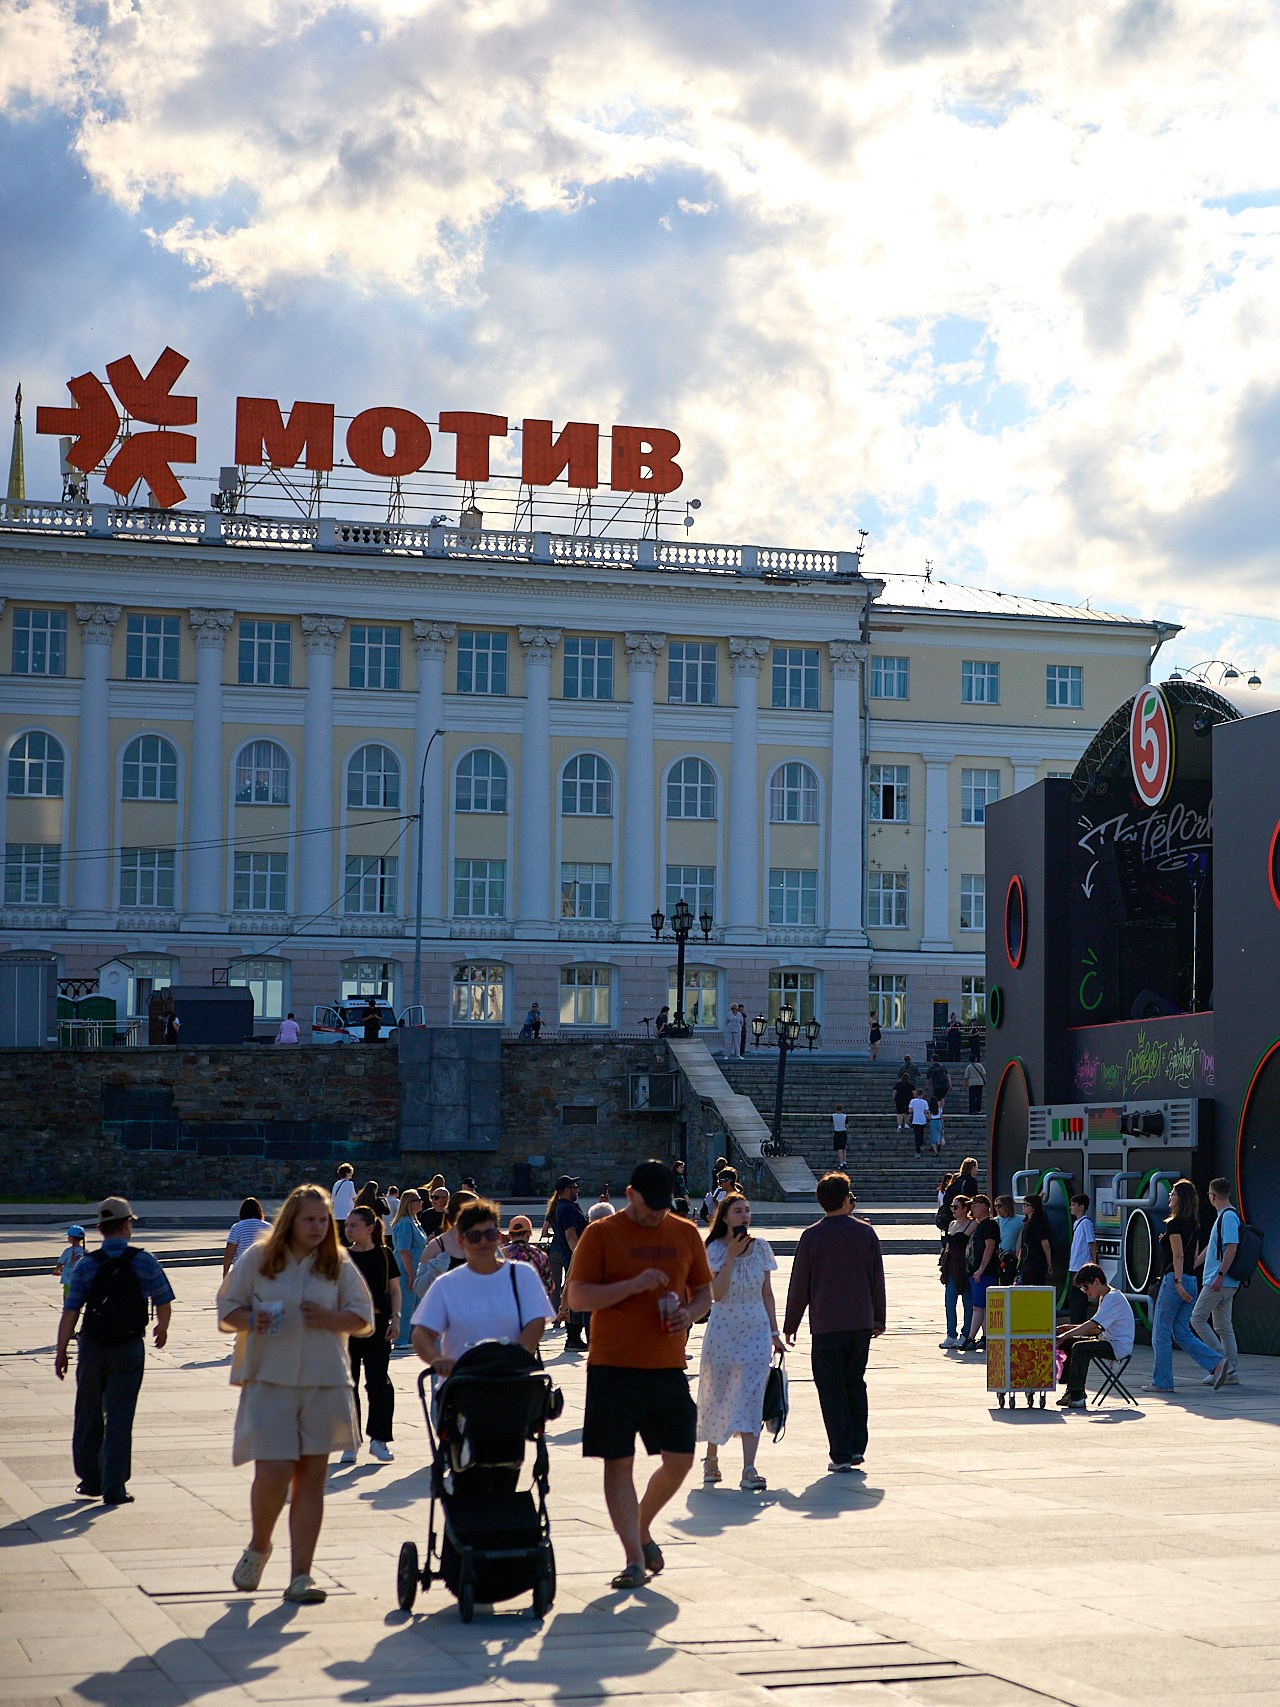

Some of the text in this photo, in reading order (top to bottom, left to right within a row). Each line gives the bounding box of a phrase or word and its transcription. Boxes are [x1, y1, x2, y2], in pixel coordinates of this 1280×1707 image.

[234, 395, 683, 495] МОТИВ
[1141, 691, 1160, 783] 5
[990, 1311, 1004, 1328] ВАТА
